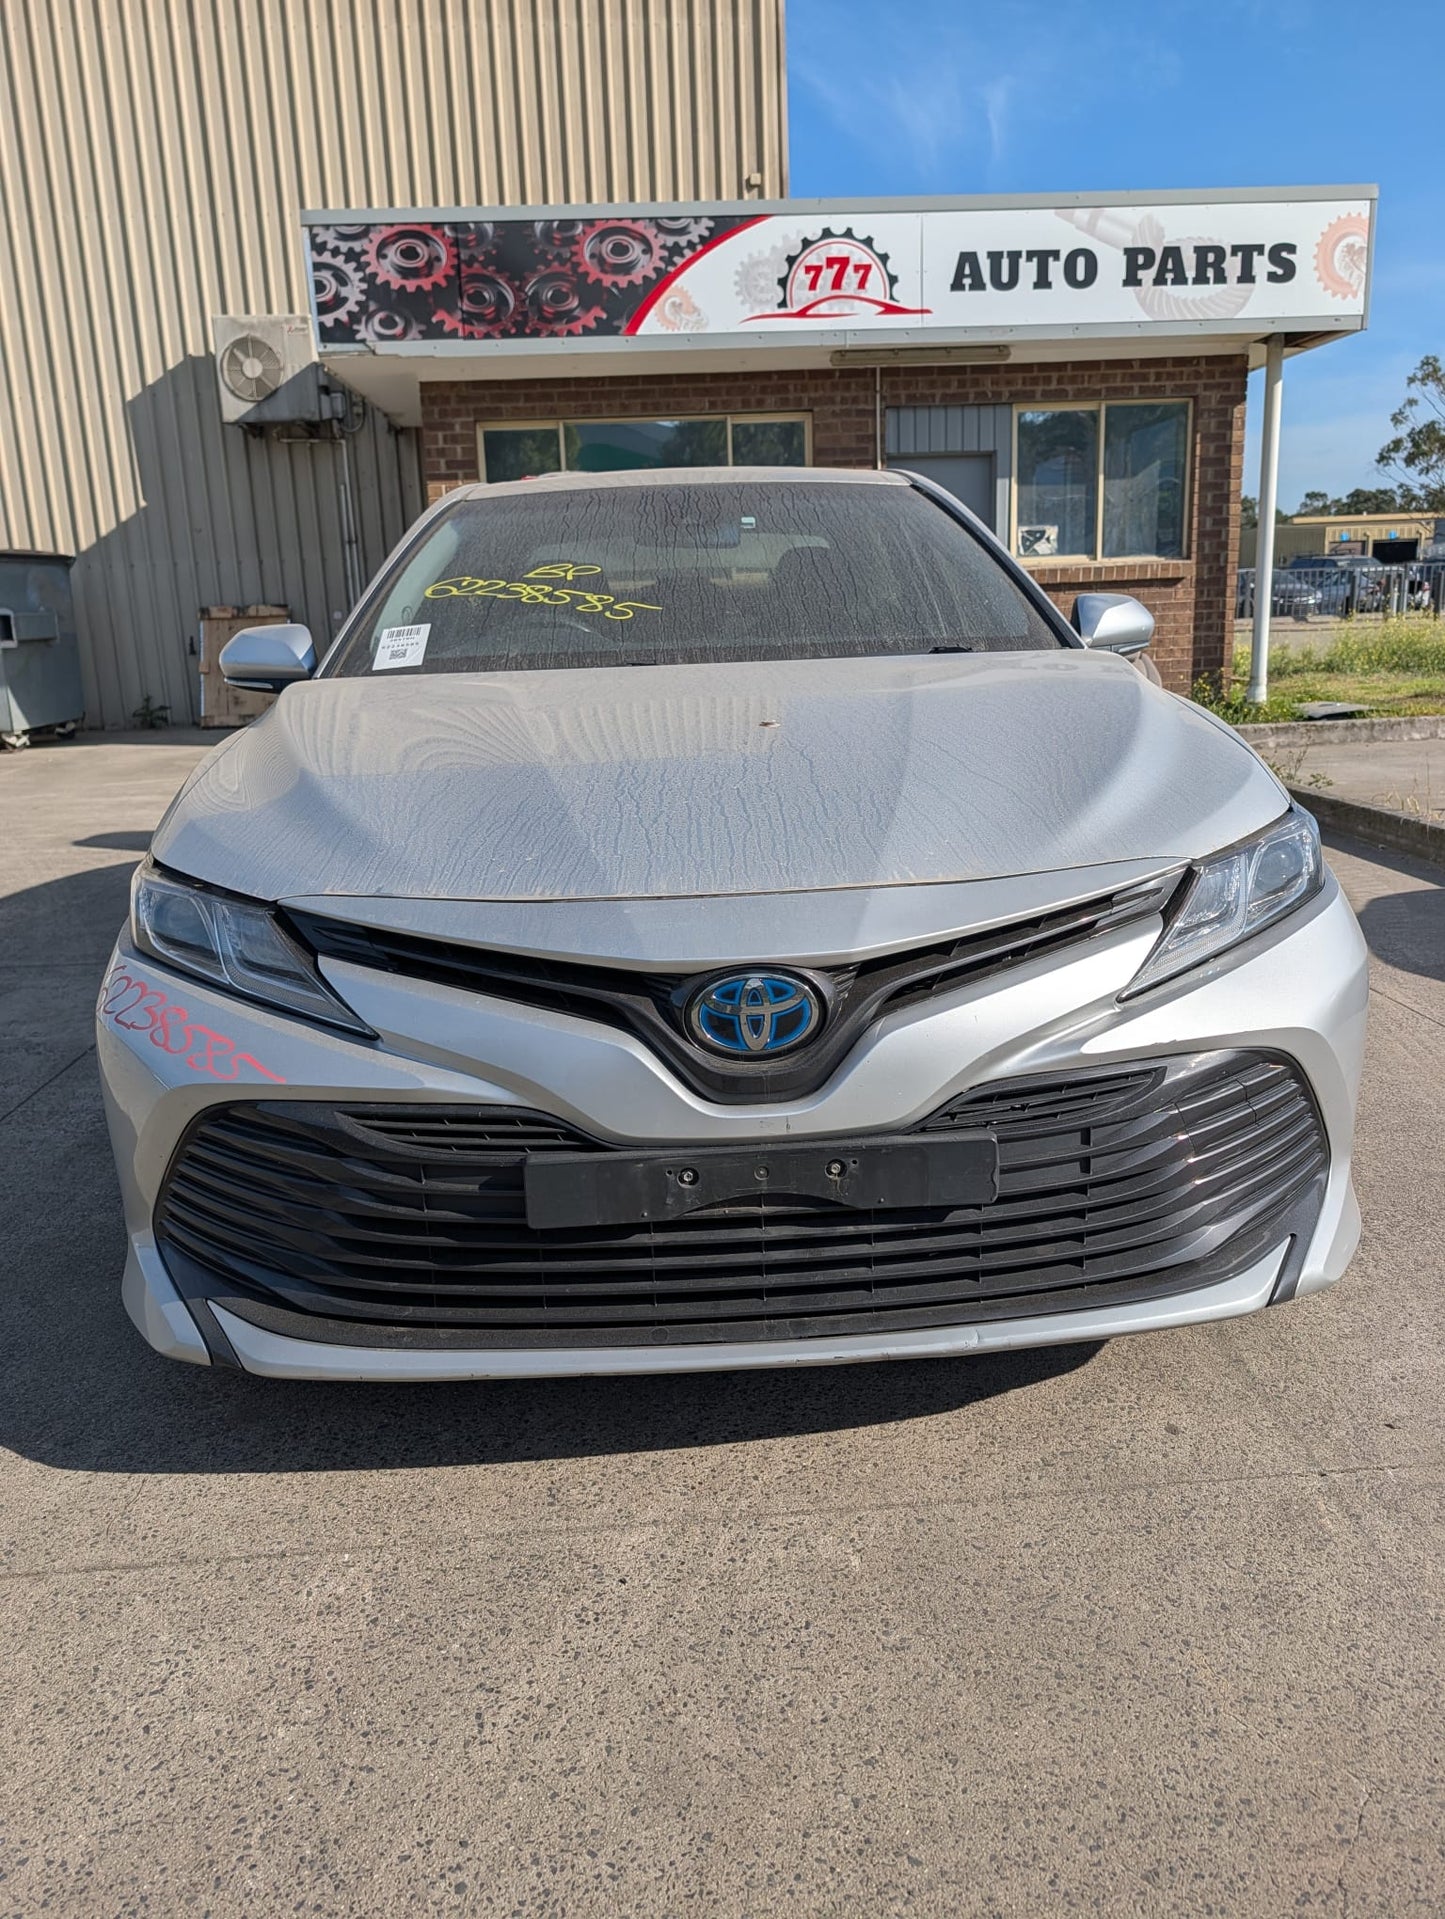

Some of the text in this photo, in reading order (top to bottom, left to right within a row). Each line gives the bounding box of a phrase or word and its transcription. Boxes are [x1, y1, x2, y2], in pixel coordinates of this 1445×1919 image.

[804, 256, 872, 291] 777
[949, 243, 1297, 292] AUTO PARTS
[424, 577, 663, 620] 62238585
